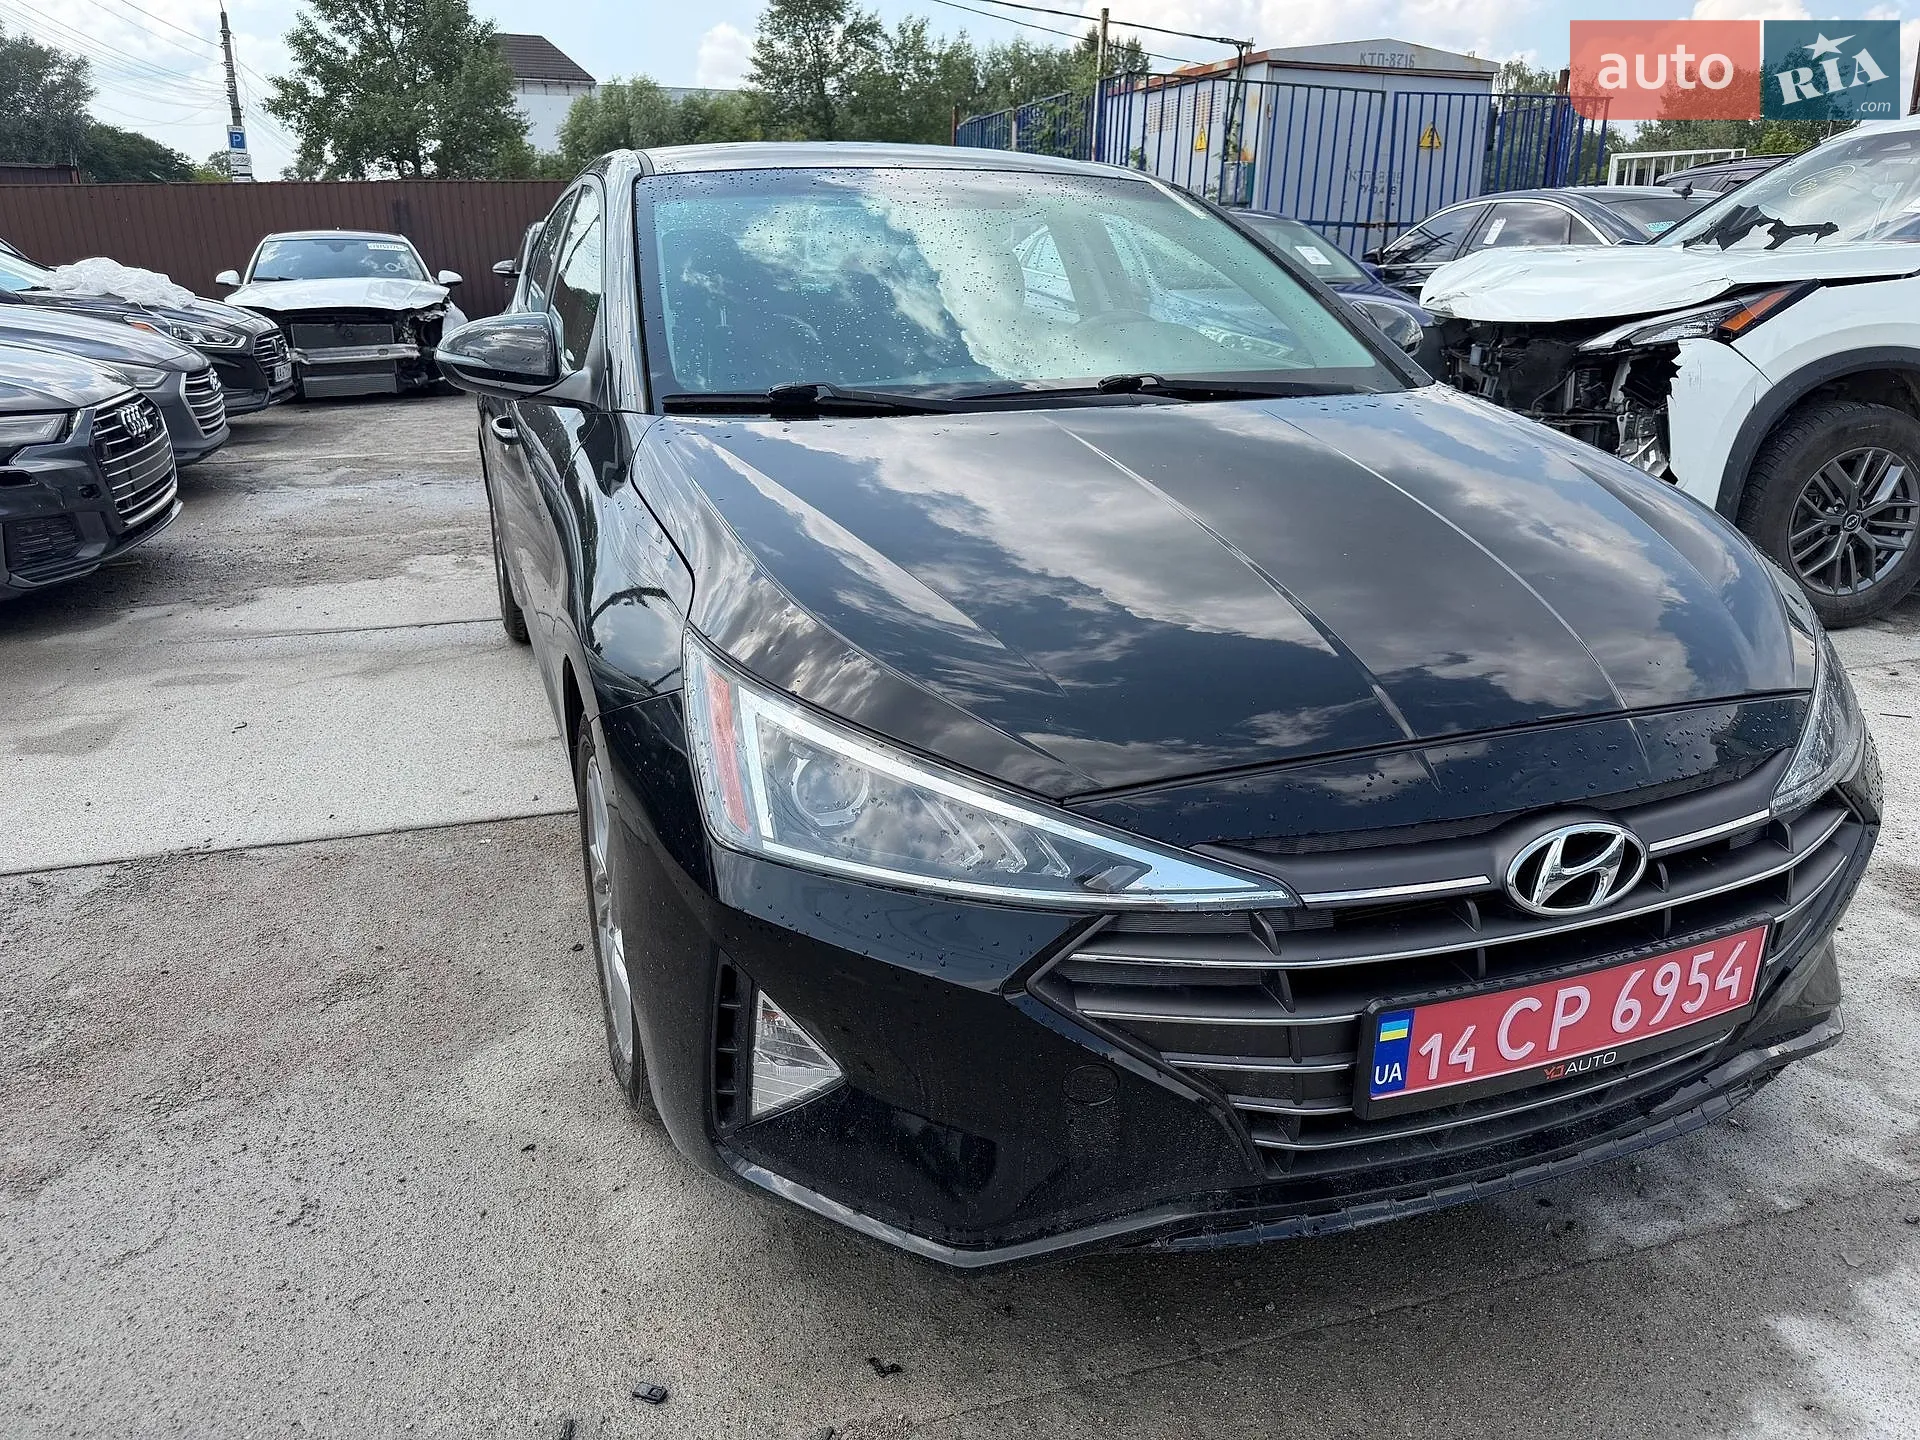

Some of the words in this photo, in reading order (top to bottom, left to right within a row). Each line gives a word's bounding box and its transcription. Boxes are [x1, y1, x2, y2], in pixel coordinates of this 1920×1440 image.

[1418, 1024, 1477, 1081] 14
[1497, 985, 1591, 1061] CP
[1612, 940, 1748, 1033] 6954
[1374, 1062, 1403, 1085] UA
